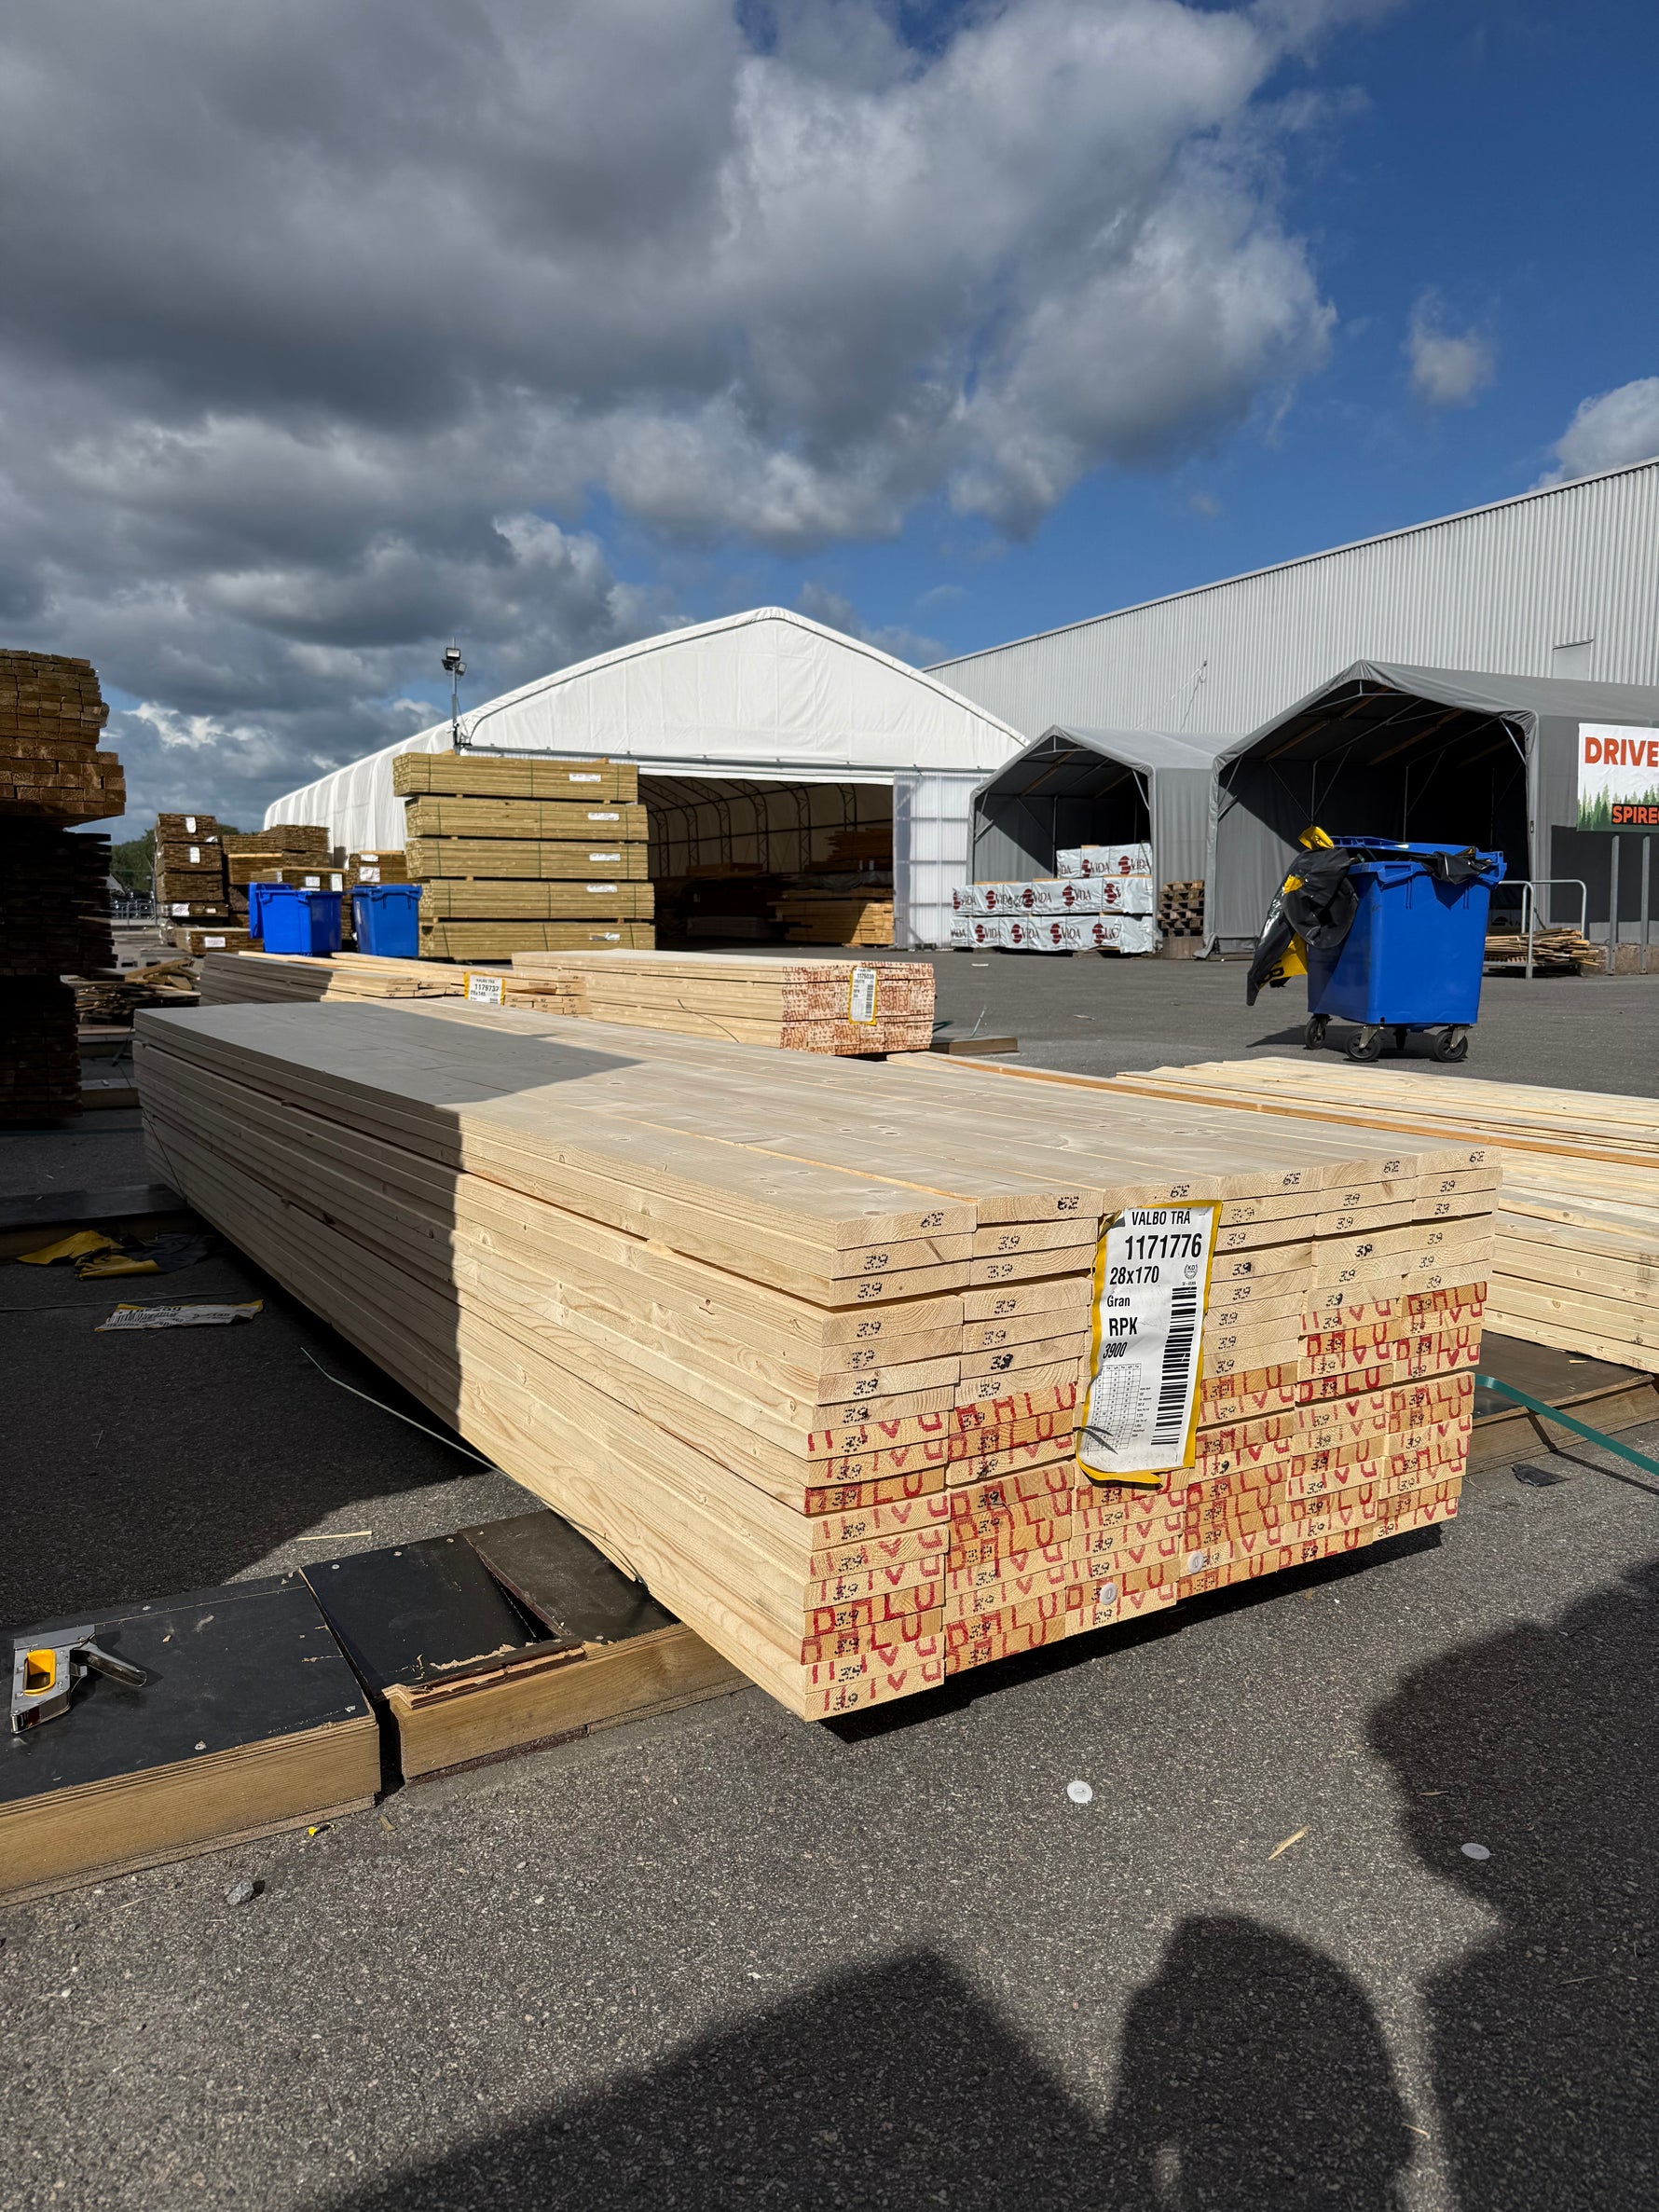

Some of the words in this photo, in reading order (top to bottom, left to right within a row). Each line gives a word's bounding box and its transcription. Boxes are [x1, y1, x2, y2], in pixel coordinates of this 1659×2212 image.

[1584, 736, 1659, 767] DRIVE
[1131, 1211, 1167, 1226] VALBO
[1171, 1208, 1191, 1225] TRÄ
[1125, 1233, 1202, 1259] 1171776
[1109, 1266, 1159, 1285] 28x170
[1106, 1295, 1131, 1308] Gran
[1109, 1317, 1138, 1337] RPK
[1103, 1341, 1128, 1359] 3900
